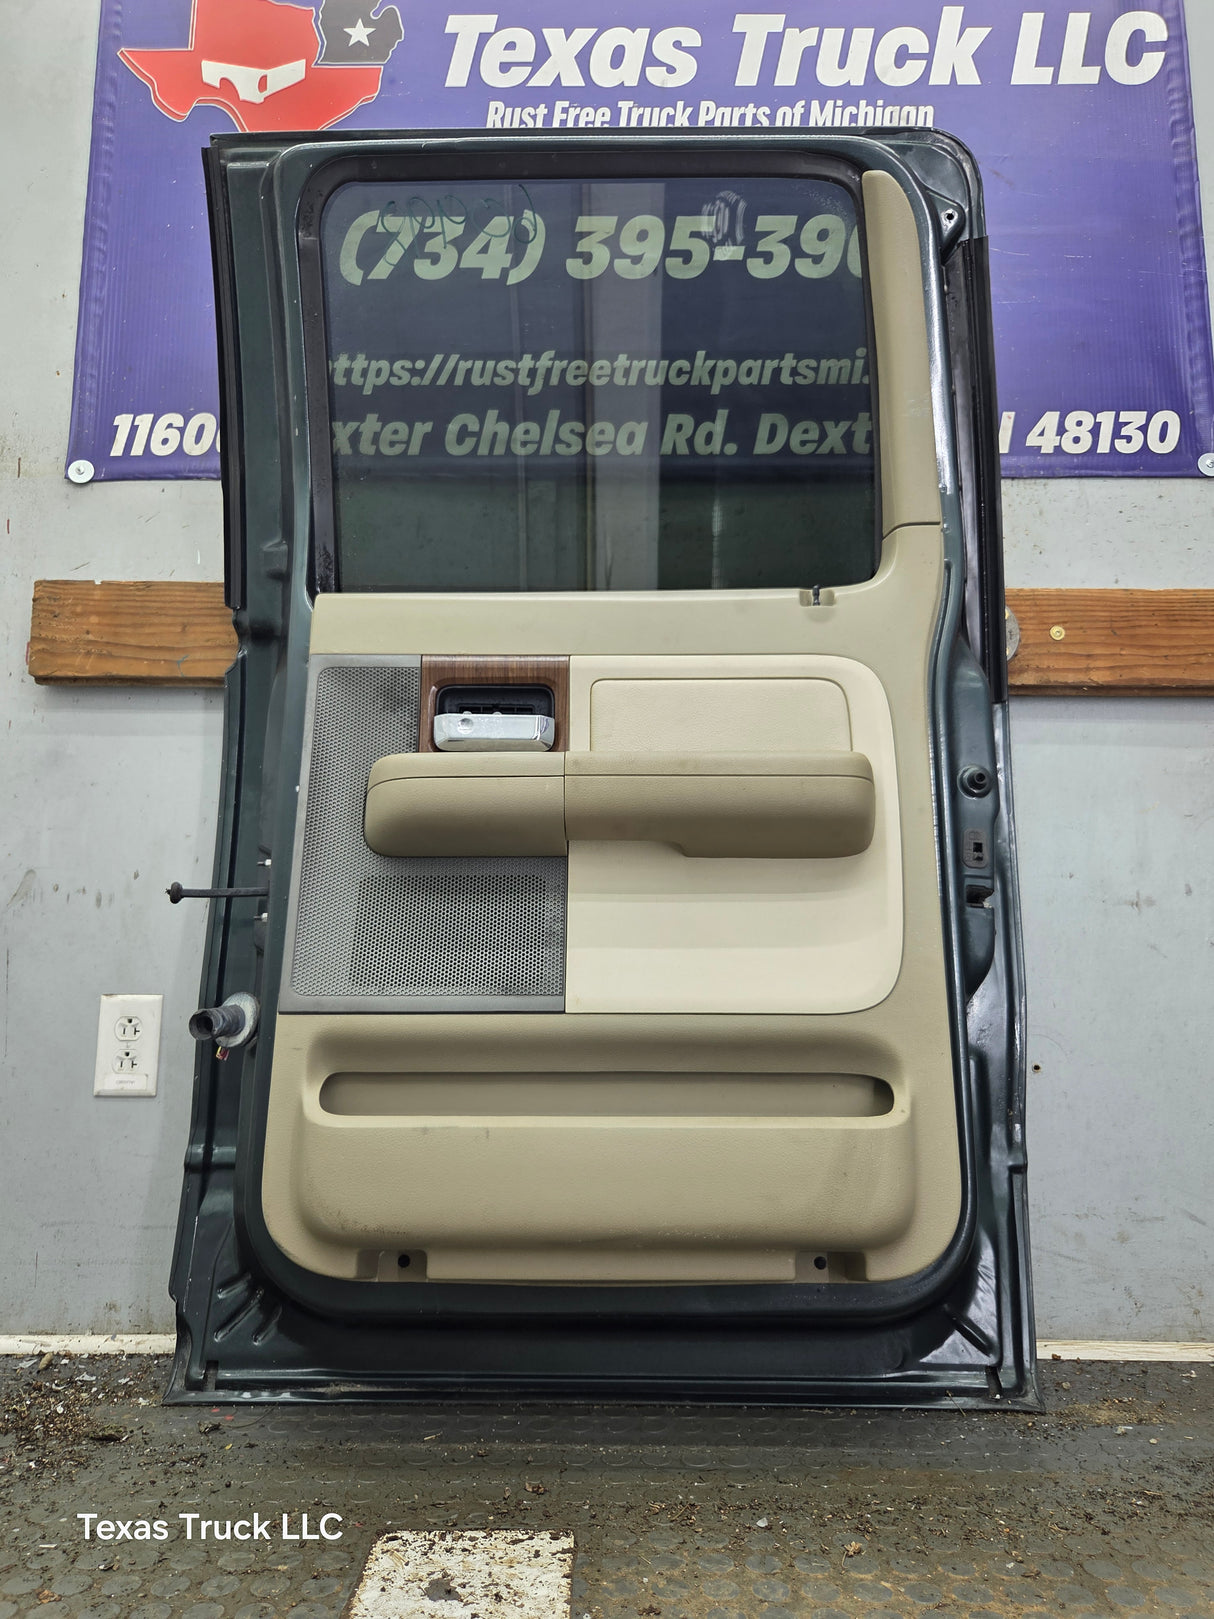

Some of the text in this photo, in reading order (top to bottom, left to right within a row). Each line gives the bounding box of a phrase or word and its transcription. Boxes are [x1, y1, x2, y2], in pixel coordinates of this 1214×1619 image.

[444, 6, 1169, 88] Texas Truck LLC
[486, 99, 935, 128] Rust Free Truck Parts of Michigan
[339, 209, 547, 287] (734)
[329, 347, 870, 396] ttps://rustfreetruckpartsmi.
[109, 412, 221, 457] 1160
[444, 409, 649, 456] Chelsea
[659, 409, 739, 456] Rd.
[753, 412, 872, 456] Dext
[1025, 410, 1181, 454] 48130
